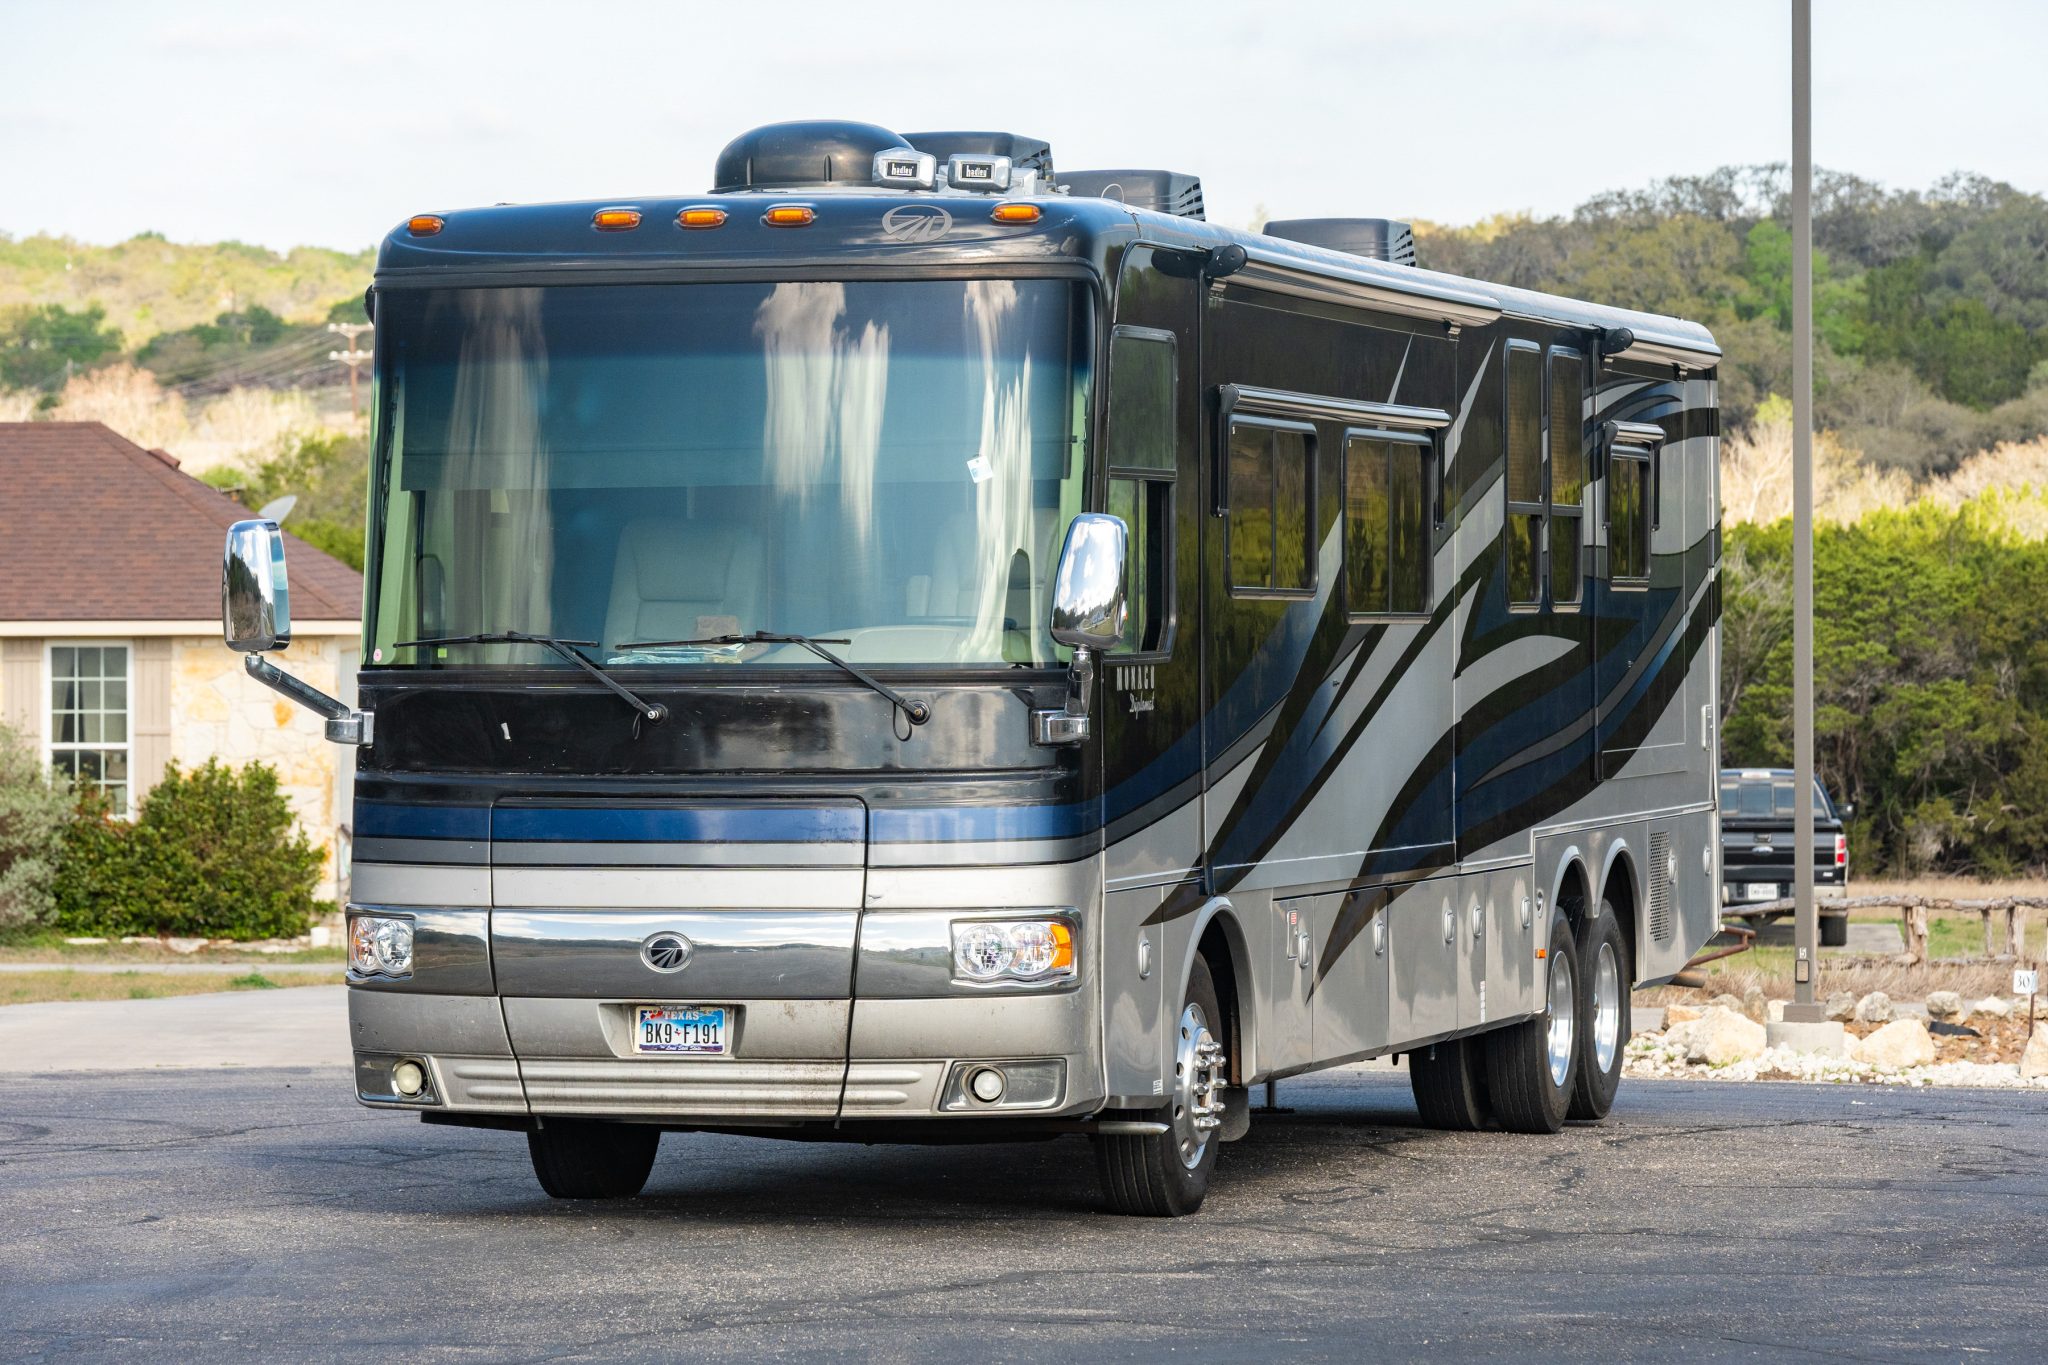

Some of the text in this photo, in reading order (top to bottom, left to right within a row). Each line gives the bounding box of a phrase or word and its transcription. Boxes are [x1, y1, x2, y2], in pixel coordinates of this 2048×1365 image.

[891, 163, 913, 177] hadley
[965, 165, 987, 178] hadley
[1116, 665, 1155, 691] MONACO
[2017, 975, 2030, 988] 30
[663, 1010, 699, 1020] TEXAS
